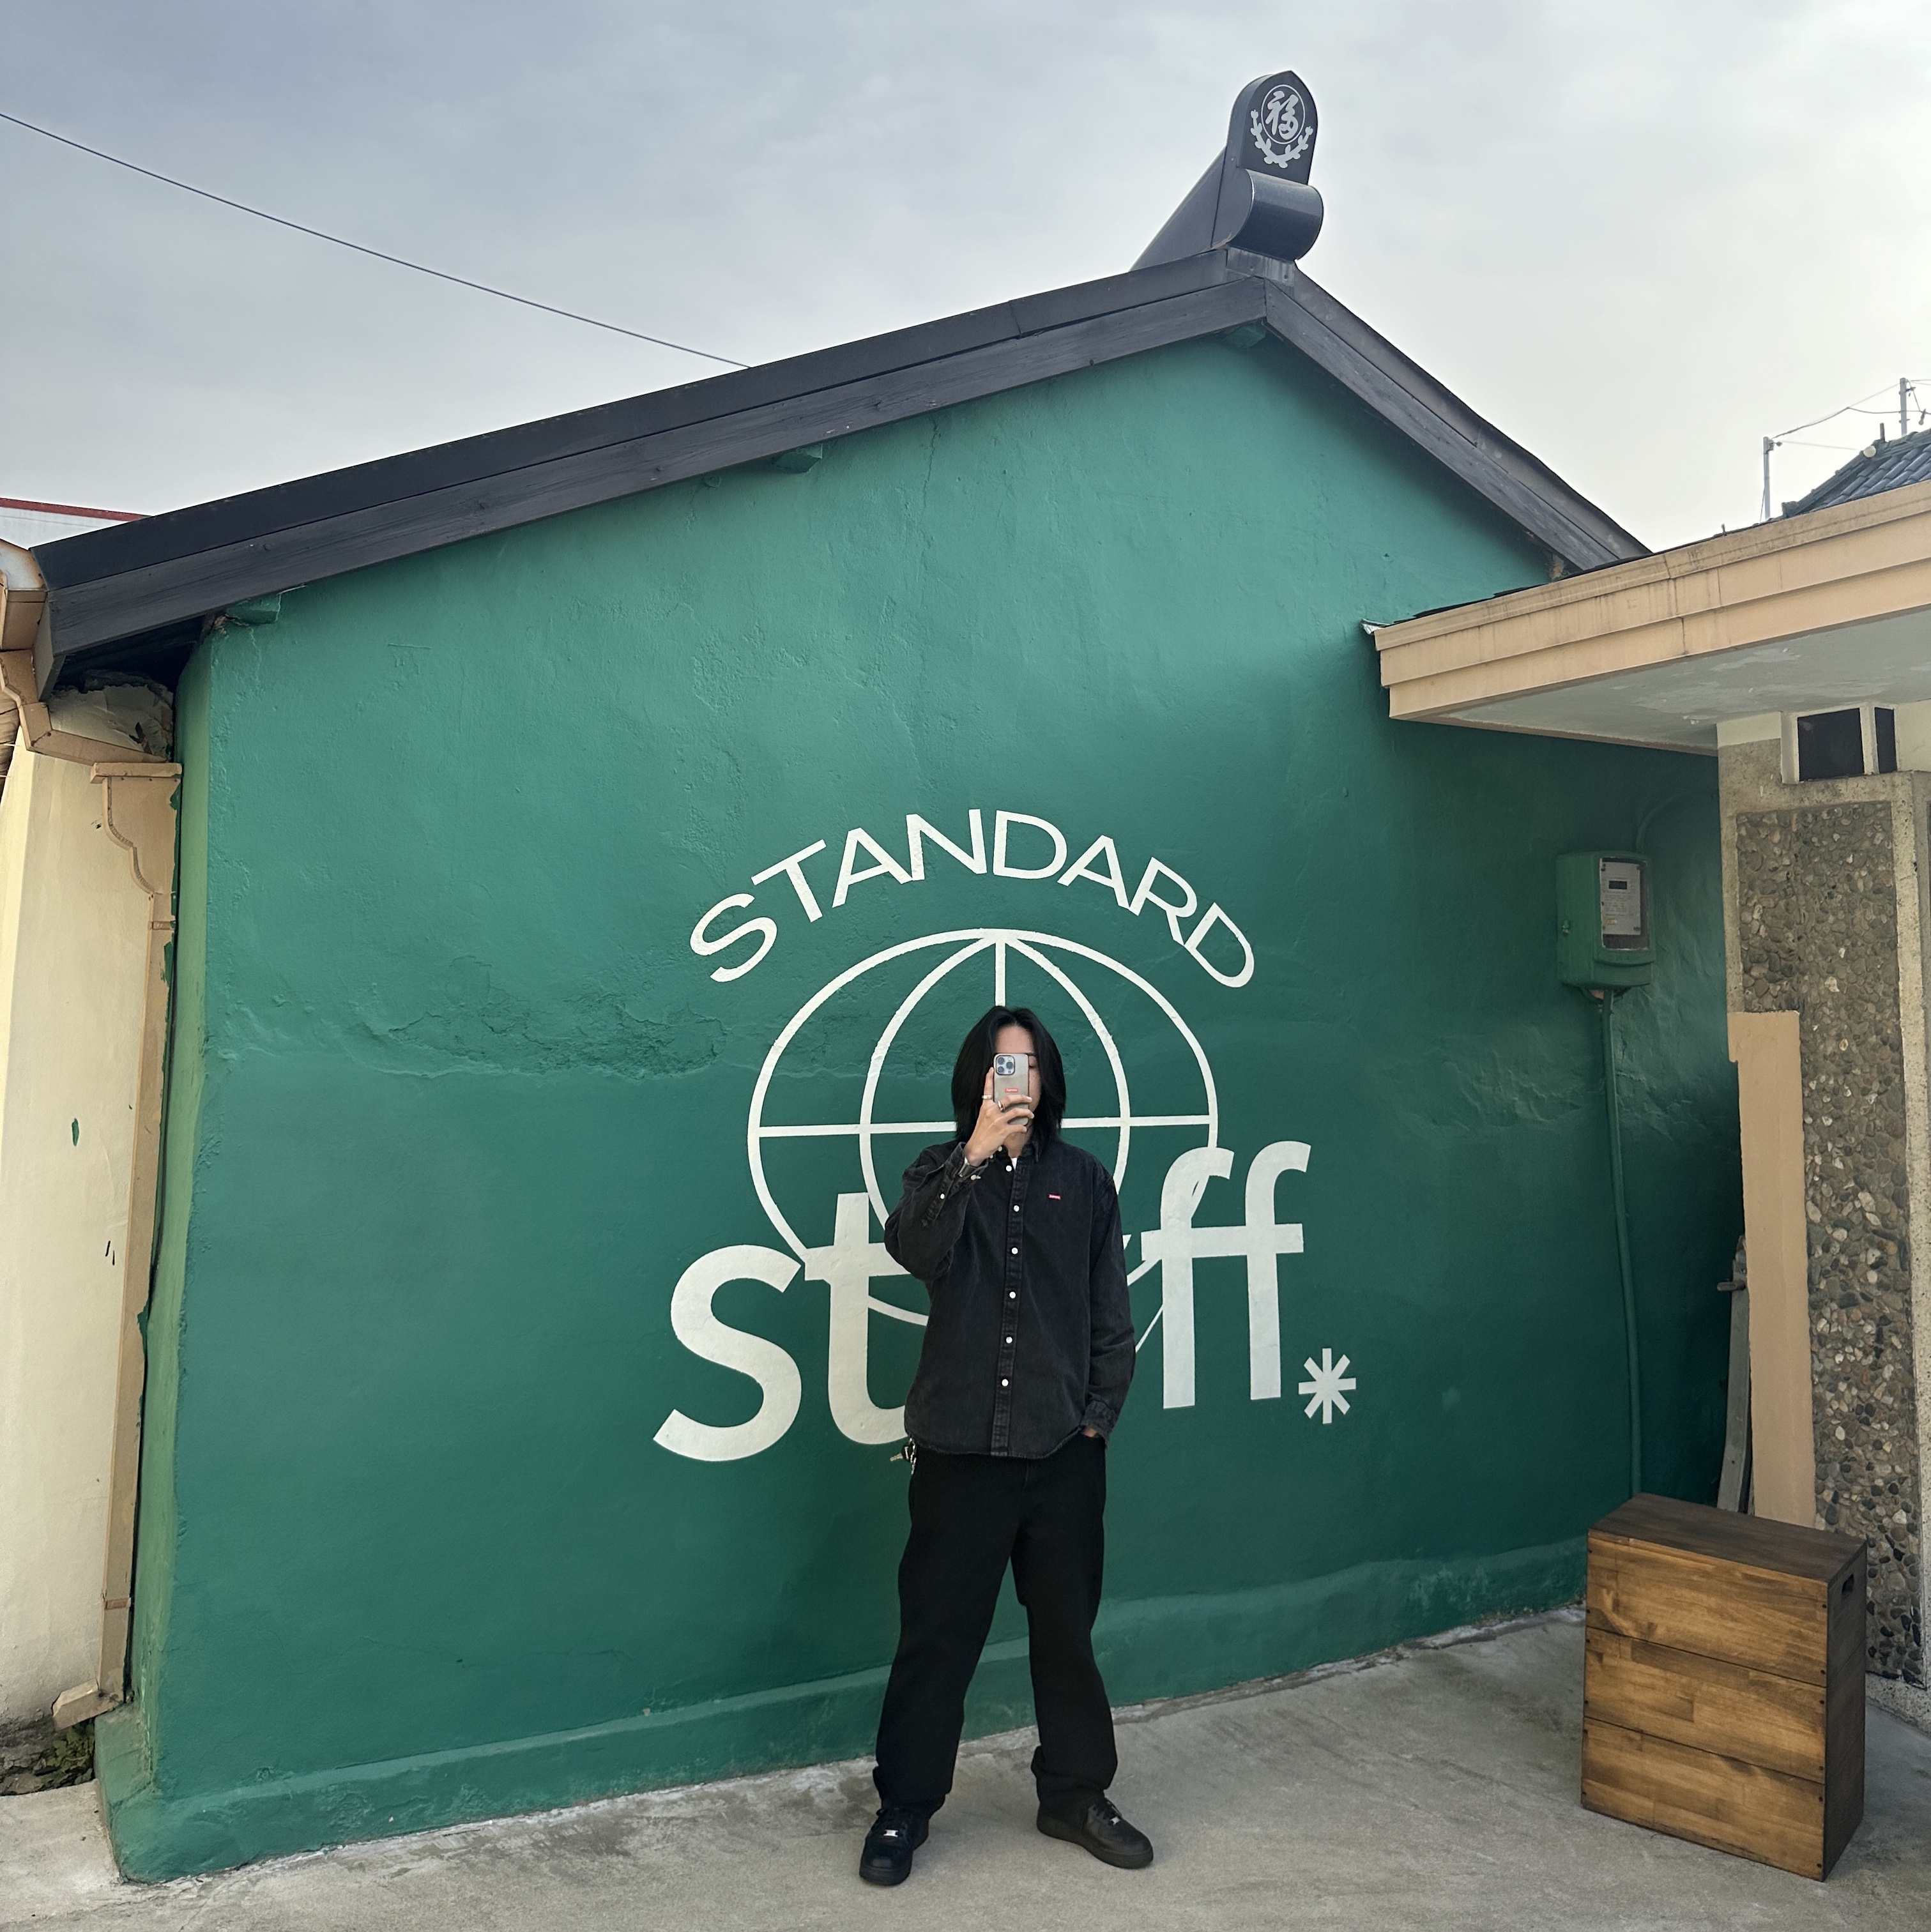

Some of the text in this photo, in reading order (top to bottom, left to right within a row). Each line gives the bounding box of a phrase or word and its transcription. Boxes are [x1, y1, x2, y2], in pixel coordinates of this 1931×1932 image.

[1265, 90, 1299, 140] 福
[690, 809, 1255, 988] STANDARD
[653, 1141, 1311, 1461] stff
